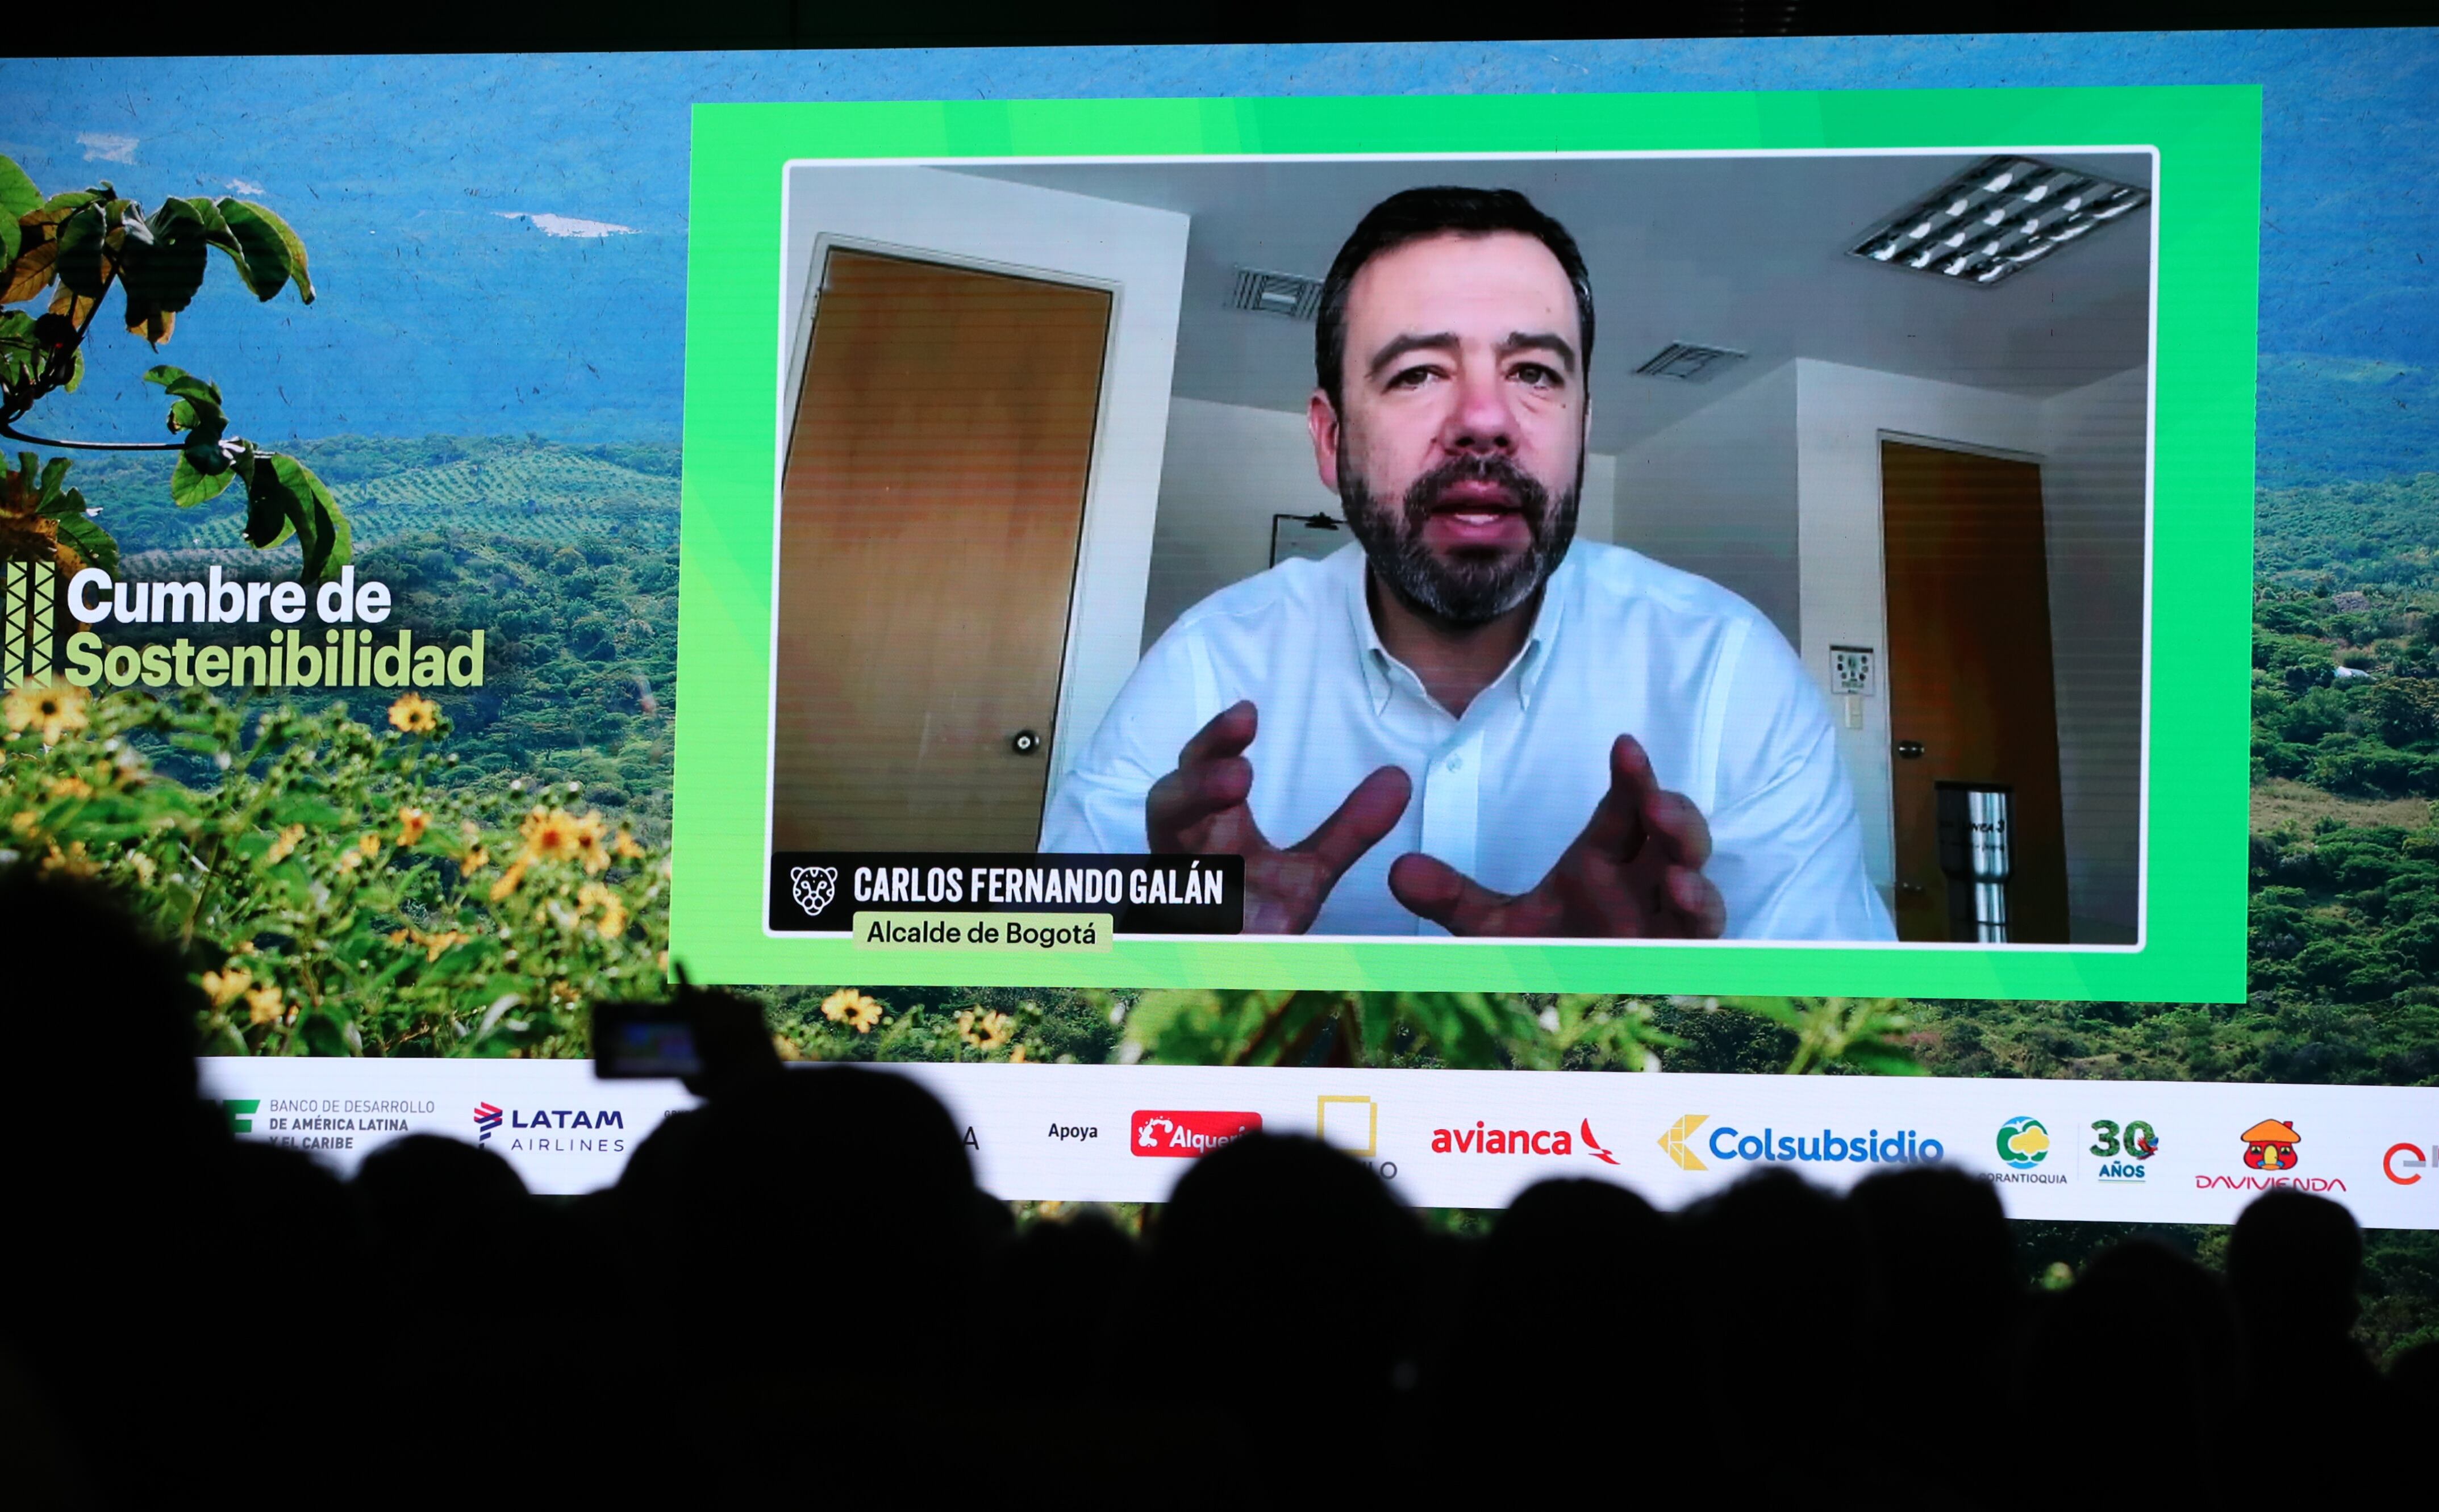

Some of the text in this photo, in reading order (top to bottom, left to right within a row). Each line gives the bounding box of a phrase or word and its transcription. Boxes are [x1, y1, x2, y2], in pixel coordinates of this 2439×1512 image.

[67, 565, 391, 624] Cumbre de
[64, 628, 485, 688] Sostenibilidad
[853, 861, 1223, 905] CARLOS FERNANDO GALÁN
[867, 921, 1096, 948] Alcalde de Bogotá
[270, 1099, 435, 1113] BANCO DE DESARROLLO
[269, 1115, 408, 1131] DE AMÉRICA LATINA
[512, 1110, 624, 1129] LATAM
[1048, 1123, 1098, 1141] Apoya
[1432, 1121, 1572, 1155] avianca
[2089, 1120, 2158, 1159] 30
[281, 1137, 299, 1149] EL
[302, 1137, 353, 1150] CARIBE
[511, 1139, 624, 1152] AIRLINES
[1710, 1127, 1944, 1165] Colsubsidio
[2099, 1161, 2146, 1178] AÑOS
[2195, 1176, 2346, 1192] DAVIVIENDA
